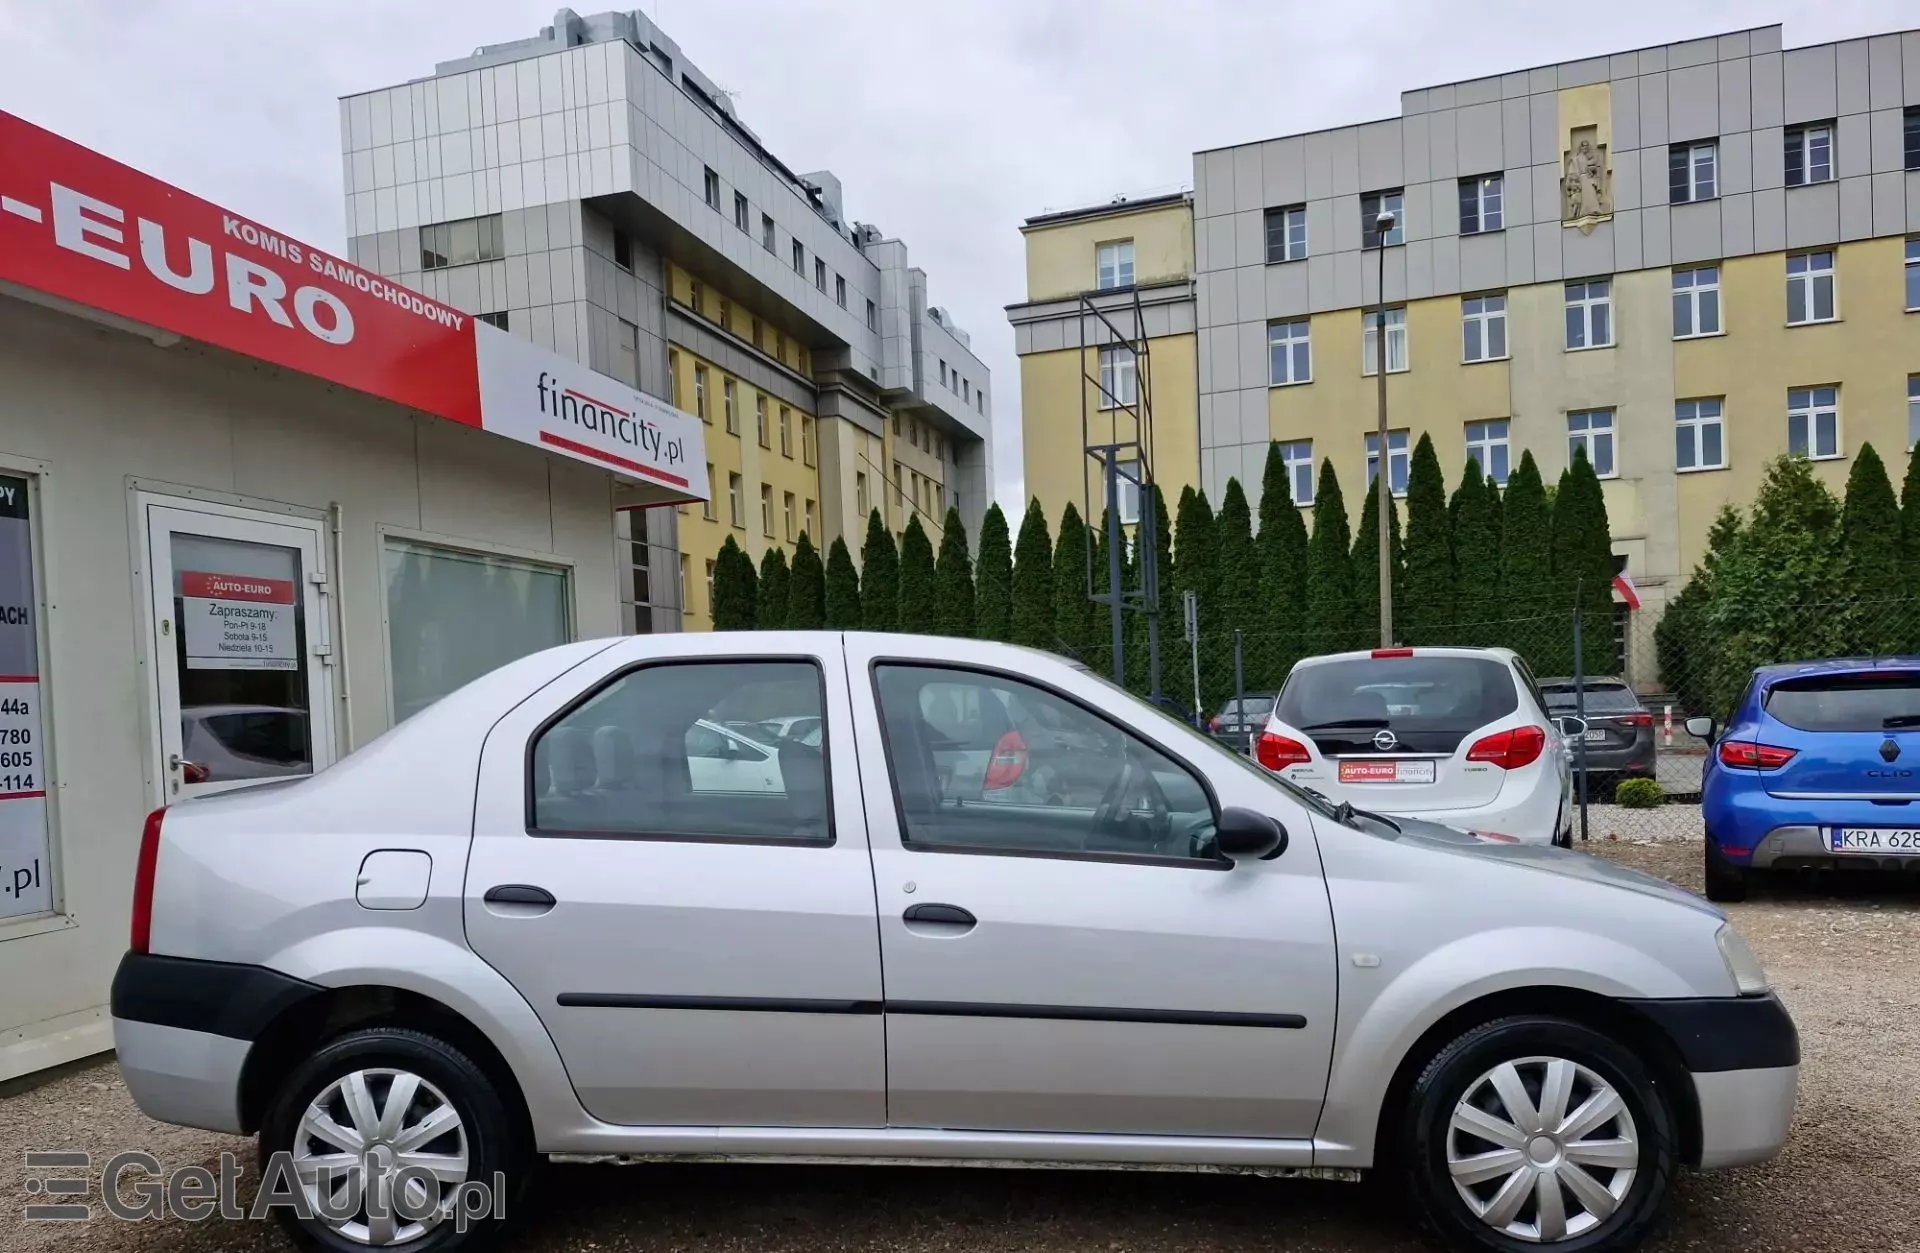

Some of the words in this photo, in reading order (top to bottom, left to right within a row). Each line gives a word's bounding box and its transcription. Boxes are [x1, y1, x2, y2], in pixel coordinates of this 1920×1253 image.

[223, 215, 302, 264] KOMIS
[309, 252, 464, 331] SAMOCHODOWY
[537, 371, 684, 465] financity.pl
[213, 581, 272, 595] AUTO-EURO
[0, 606, 28, 625] ACH
[209, 603, 279, 621] Zapraszamy:
[250, 622, 267, 631] 9-18
[224, 632, 250, 641] Sobota
[251, 633, 268, 642] 9-15
[218, 643, 252, 652] Niedziela
[254, 644, 273, 653] 10-15
[0, 698, 29, 715] 44a
[0, 728, 31, 745] 780
[0, 751, 32, 768] 605
[1344, 767, 1394, 775] AUTO-EURO
[1867, 770, 1912, 778] CLIO
[1843, 830, 1882, 848] KRA
[0, 858, 40, 899] .pl
